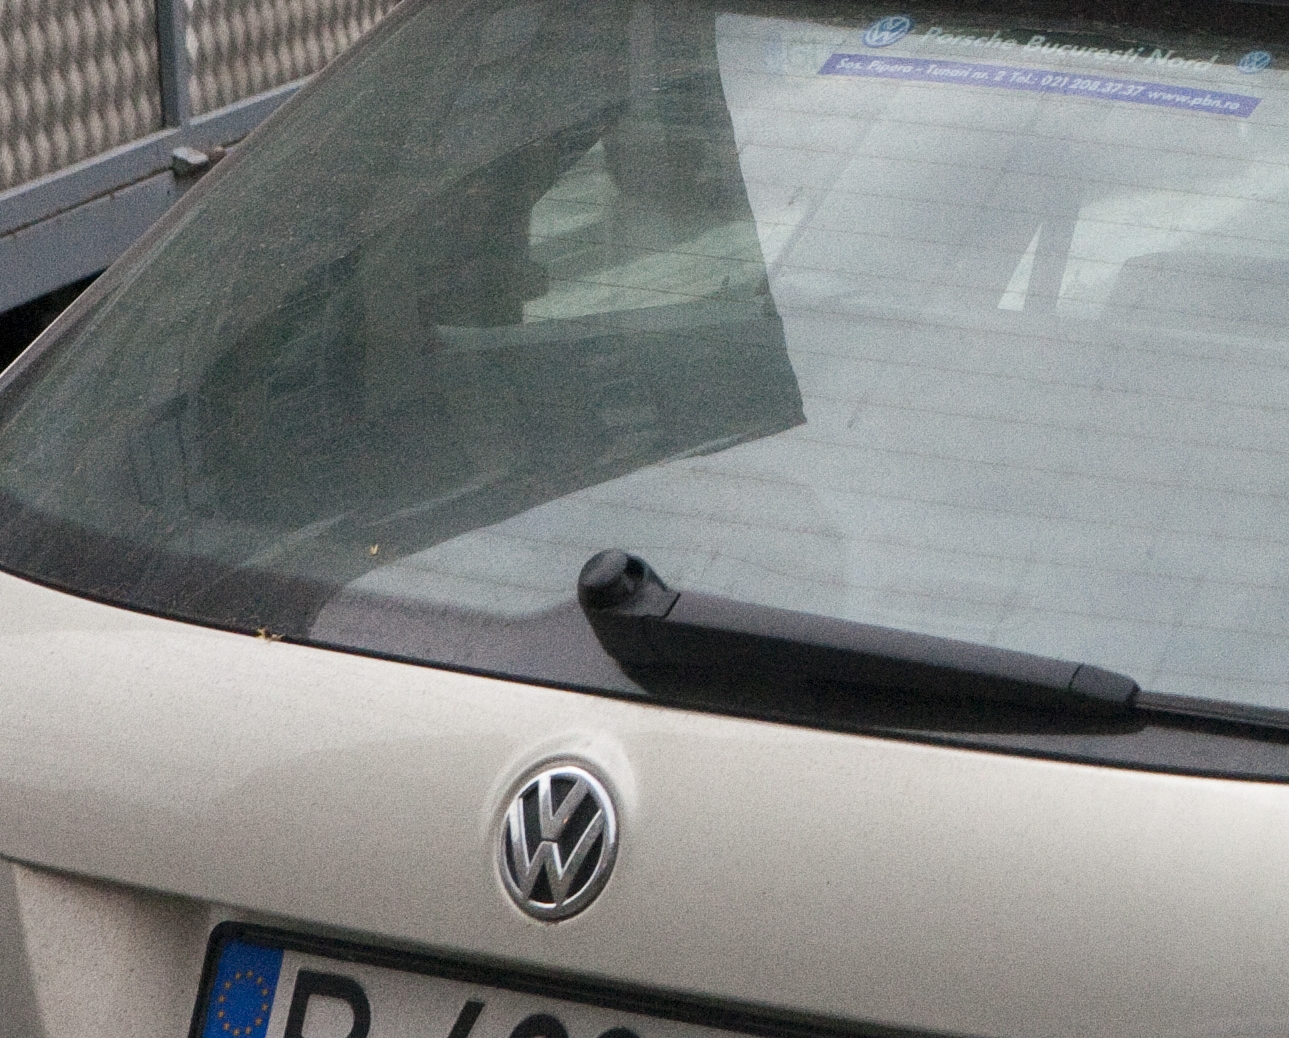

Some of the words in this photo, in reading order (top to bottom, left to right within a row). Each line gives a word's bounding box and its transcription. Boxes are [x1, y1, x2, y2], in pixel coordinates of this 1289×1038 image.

[920, 27, 1018, 52] Porsche
[1145, 47, 1220, 73] Nord
[867, 59, 911, 76] Pipera
[926, 62, 972, 79] Tunari
[993, 70, 1004, 82] 2
[1040, 74, 1070, 88] 021
[1070, 77, 1144, 98] 208.37.37
[1147, 89, 1241, 112] www.pbn.ro
